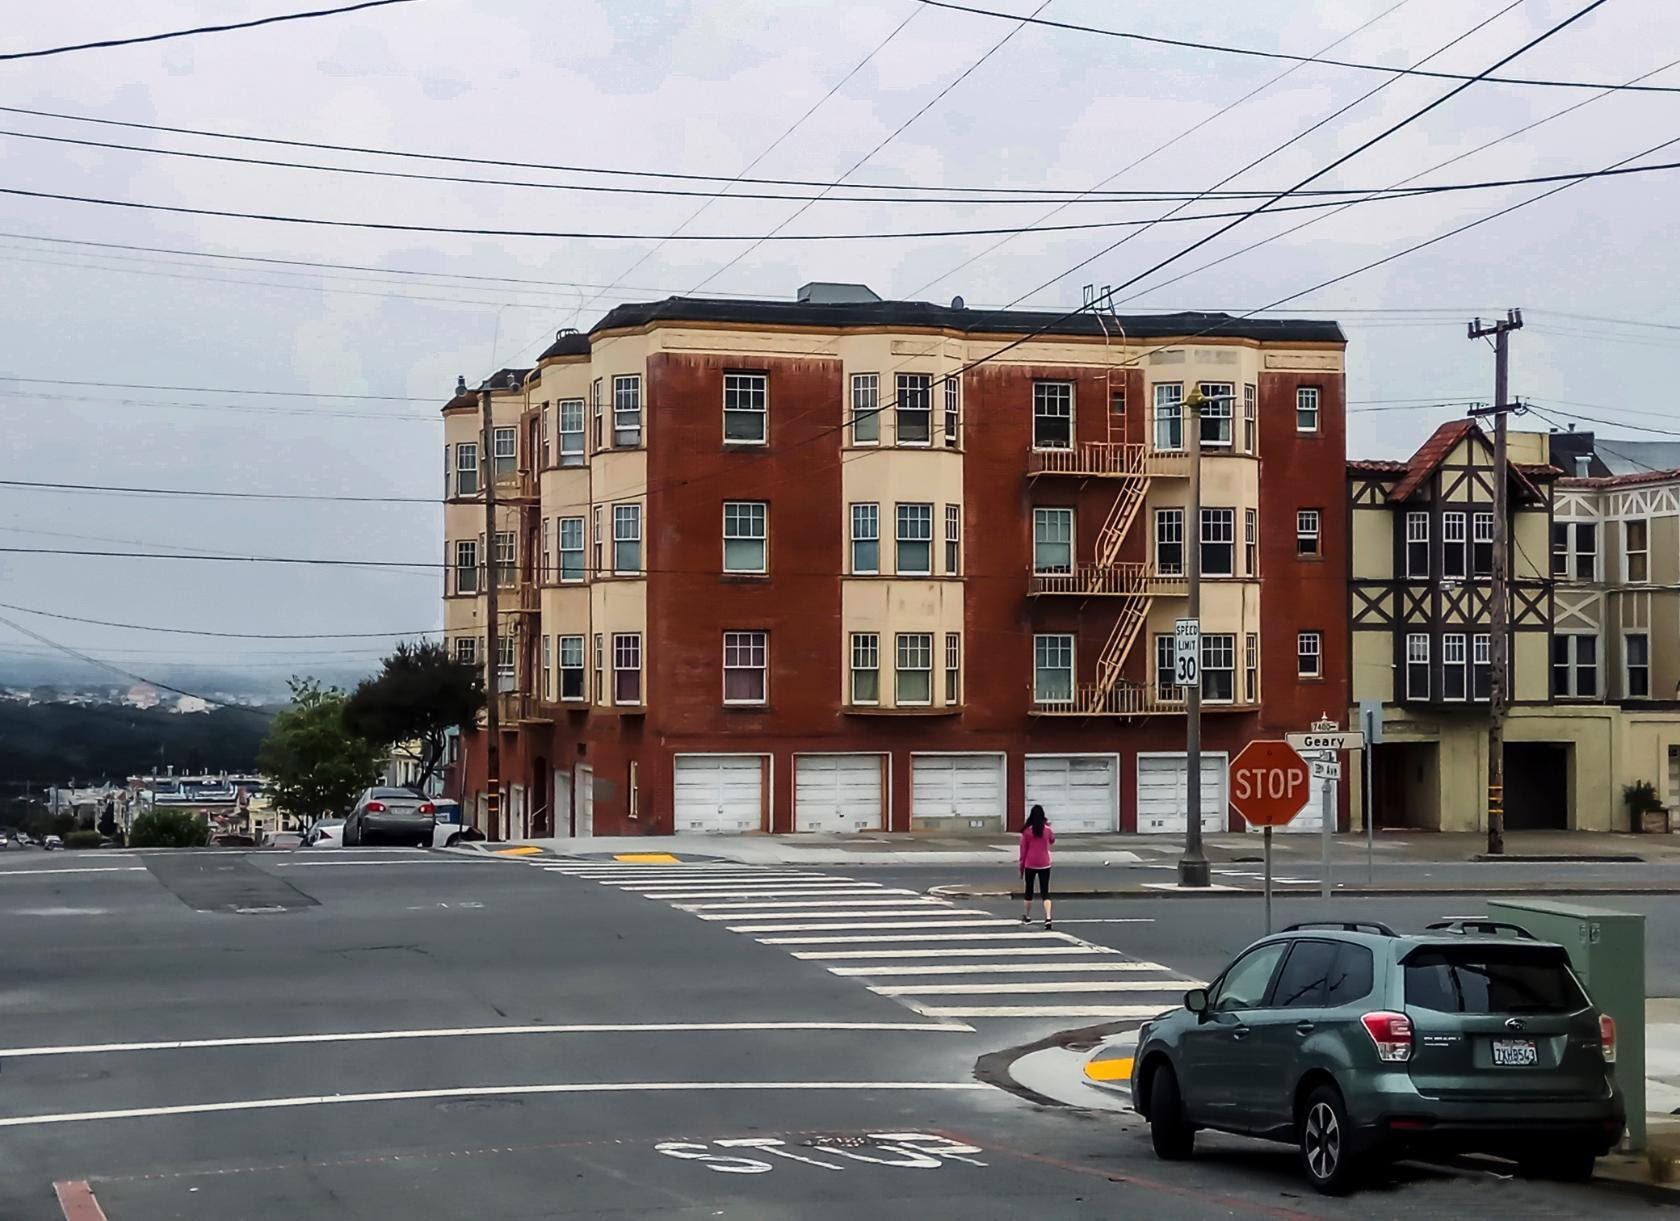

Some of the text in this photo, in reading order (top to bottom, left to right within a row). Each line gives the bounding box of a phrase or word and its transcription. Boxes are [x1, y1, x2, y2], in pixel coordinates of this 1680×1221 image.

[1176, 625, 1198, 636] SPEED
[1178, 640, 1196, 651] LIMIT
[1178, 656, 1196, 680] 30
[1304, 736, 1345, 748] Geary
[1235, 768, 1304, 799] STOP
